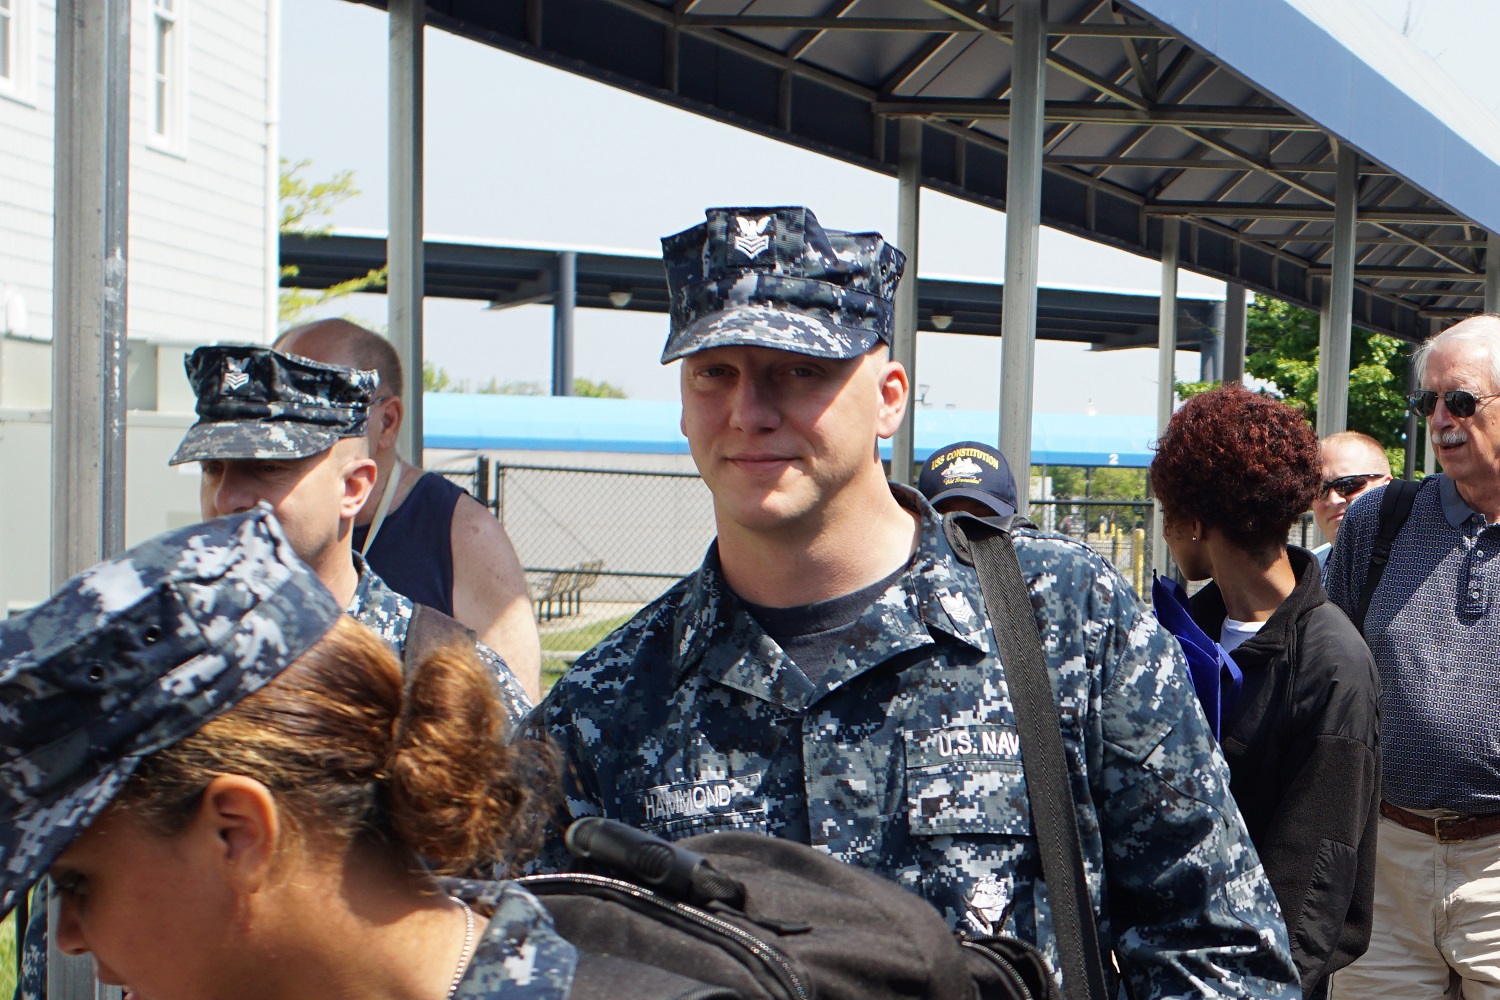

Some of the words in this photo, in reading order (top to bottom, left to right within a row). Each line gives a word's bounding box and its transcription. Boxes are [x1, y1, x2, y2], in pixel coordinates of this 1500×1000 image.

[931, 454, 945, 471] USS
[946, 447, 1000, 470] CONSTITUTION
[1108, 453, 1119, 465] 2
[938, 731, 978, 757] U.S.
[981, 730, 1020, 756] NAV
[644, 784, 732, 821] HAMMOND
